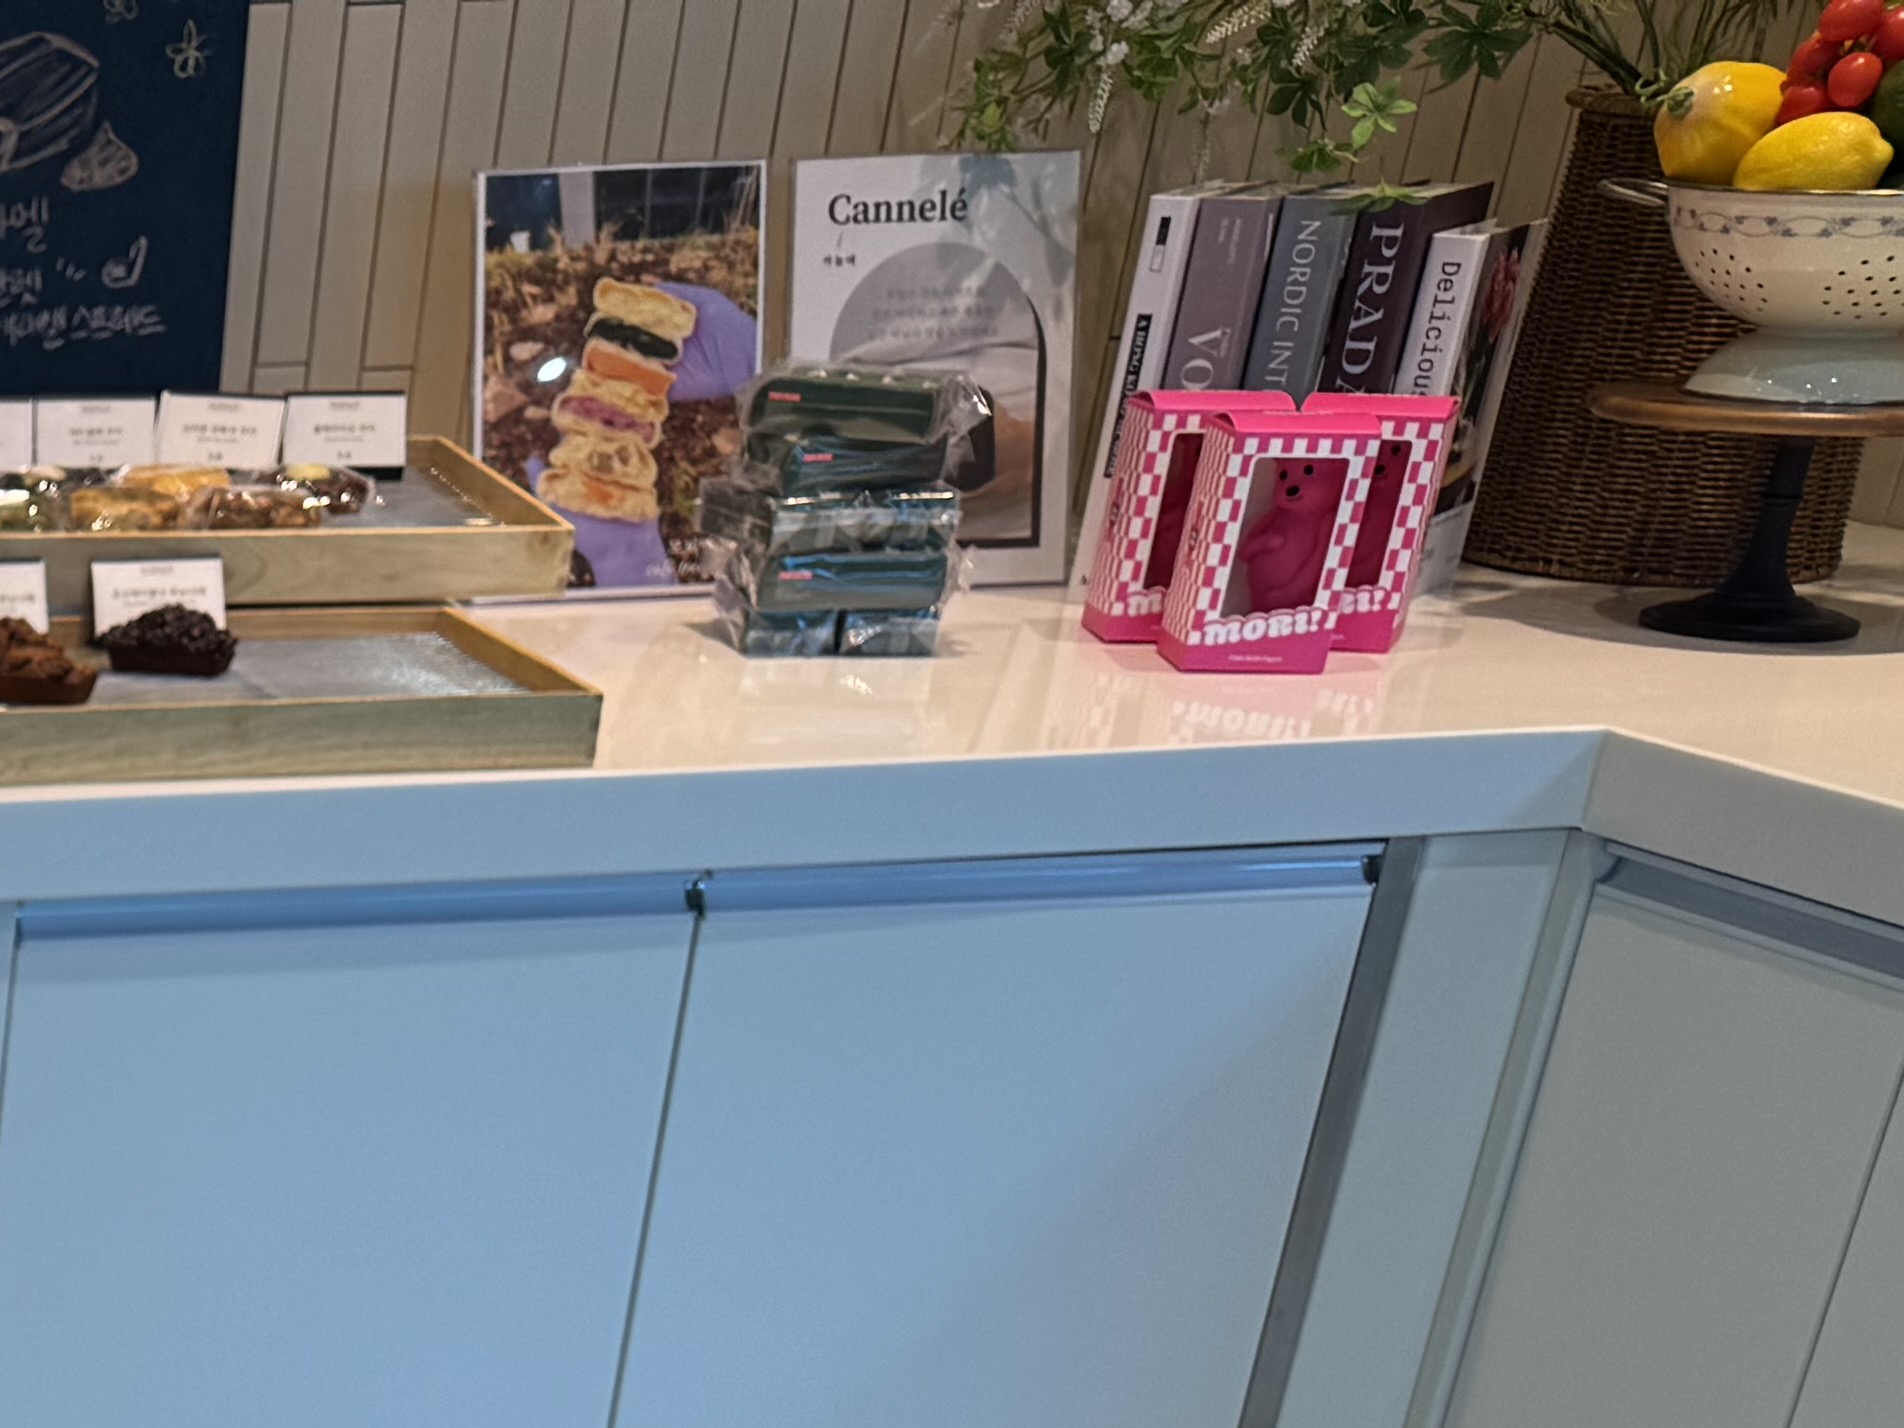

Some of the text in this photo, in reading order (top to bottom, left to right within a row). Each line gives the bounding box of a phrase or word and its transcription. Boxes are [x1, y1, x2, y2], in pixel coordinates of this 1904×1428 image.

[828, 188, 968, 225] Cannelé
[1275, 219, 1322, 332] NORDIC
[1203, 608, 1322, 645] MORI!
